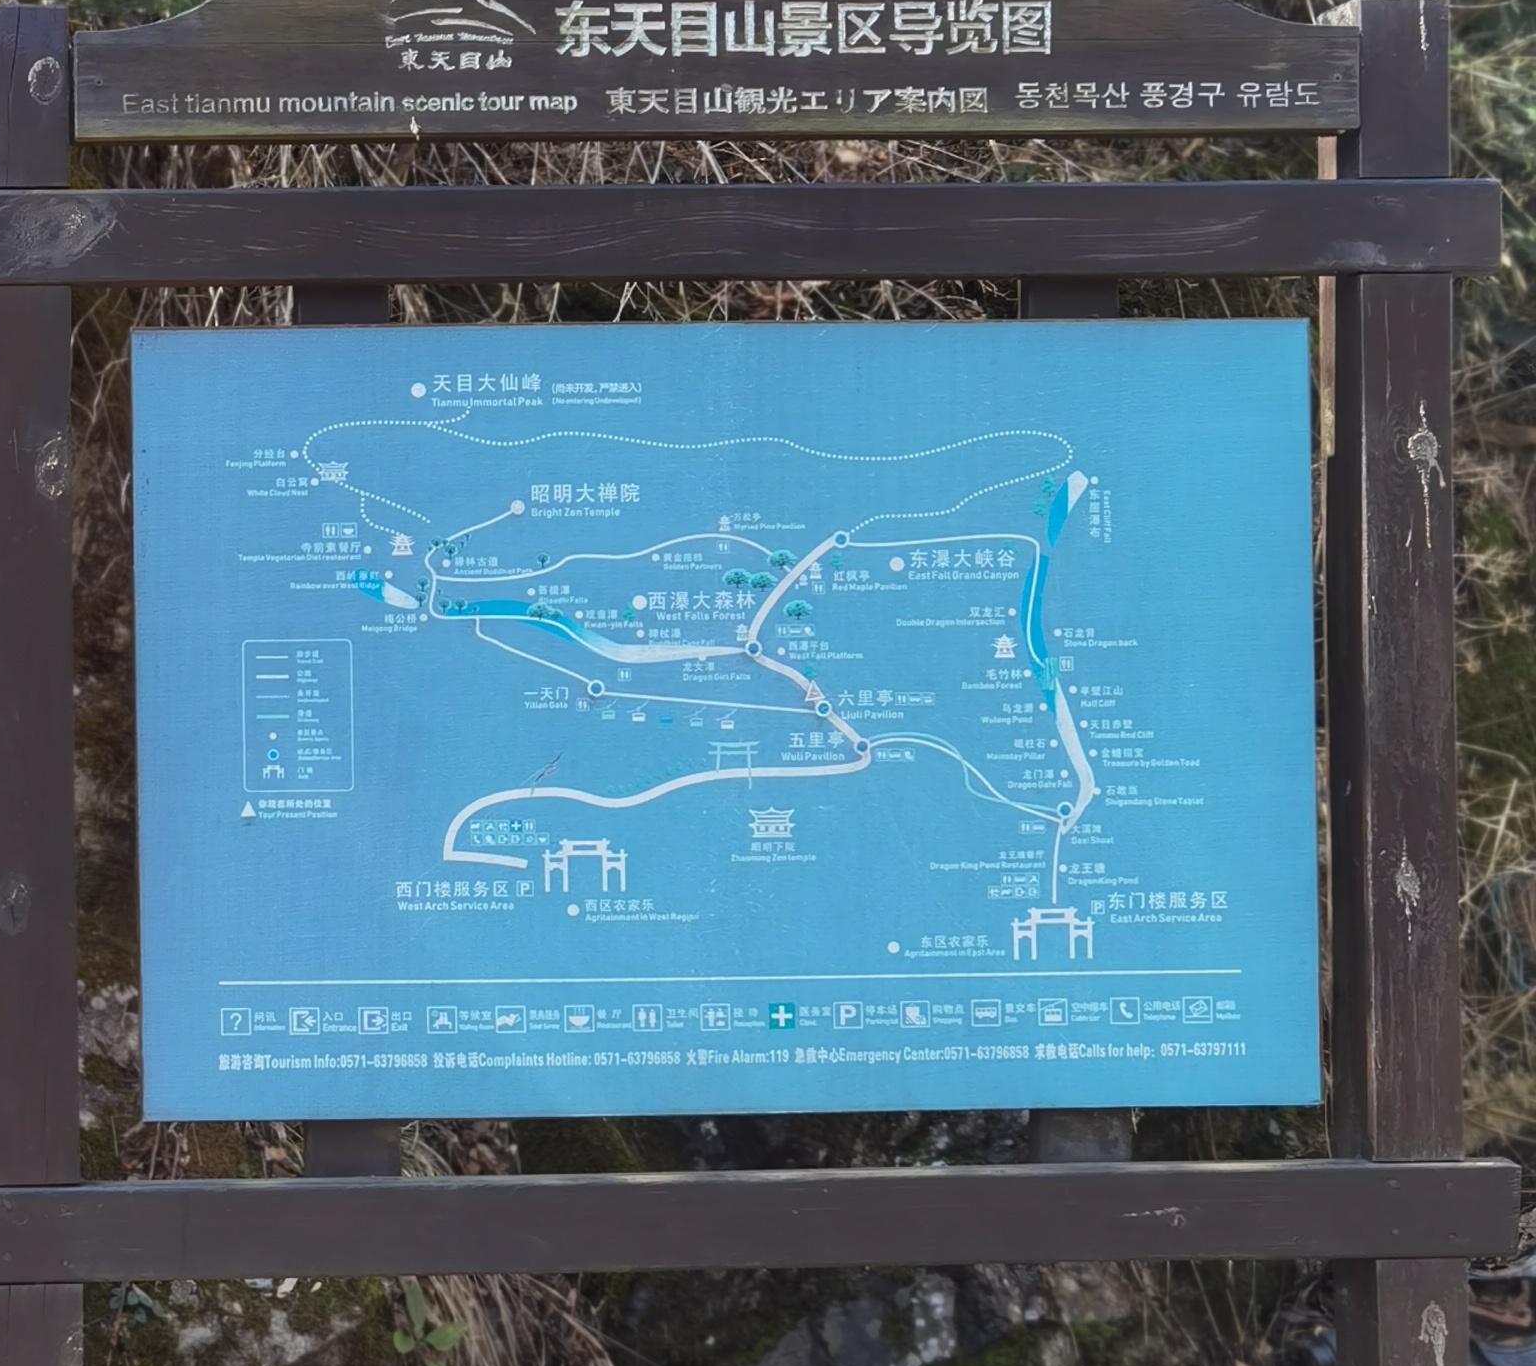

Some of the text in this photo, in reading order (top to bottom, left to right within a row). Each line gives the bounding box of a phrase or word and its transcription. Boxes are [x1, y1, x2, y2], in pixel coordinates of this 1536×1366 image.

[555, 0, 1052, 57] 东天目山景区导览图
[398, 48, 512, 71] 東天目山
[605, 85, 988, 115] 東天目山観光エリア案内図
[1014, 81, 1321, 109] 동천목산 풍경구 유람도
[123, 94, 178, 114] East
[279, 92, 394, 113] mountain
[402, 92, 474, 112] scenic
[478, 93, 524, 112] tour
[529, 95, 578, 115] map
[433, 373, 542, 393] 天目大仙峰
[432, 397, 543, 407] Tianmu Immortal Peak
[531, 483, 640, 503] 昭明大禅院
[531, 508, 621, 518] Bright Zen Temple
[909, 549, 1015, 568] 东瀑大峡谷
[908, 571, 1019, 581] East Fall Grand Canyon
[648, 591, 756, 610] 西瀑大森林
[657, 611, 745, 621] West Falls Forest
[523, 687, 569, 701] 一天门
[838, 690, 893, 707] 六里亭
[864, 710, 904, 719] Pavilion
[789, 732, 844, 748] 五里亭
[781, 752, 845, 761] Wuli Pavilion
[395, 880, 509, 898] 西门楼服务区
[521, 883, 530, 894] P
[398, 901, 515, 911] West Arch Service Area
[584, 899, 655, 912] 西区农家乐
[1107, 891, 1229, 910] 东门楼服务区
[1110, 913, 1222, 923] East Arch Service Area
[921, 936, 989, 948] 东区农家乐
[322, 1012, 344, 1022] 入口
[391, 1011, 412, 1022] 出口
[666, 1008, 699, 1019] 卫生间
[840, 1005, 856, 1025] P
[322, 1023, 357, 1032] Entrance
[391, 1023, 408, 1032] Exit
[547, 1052, 591, 1066] Hotline:
[594, 1051, 681, 1066] 0571-63796858
[732, 1049, 789, 1064] Alarm:119
[1108, 1043, 1124, 1058] for
[1126, 1042, 1155, 1059] help:
[1161, 1042, 1246, 1057] 0571-63797111
